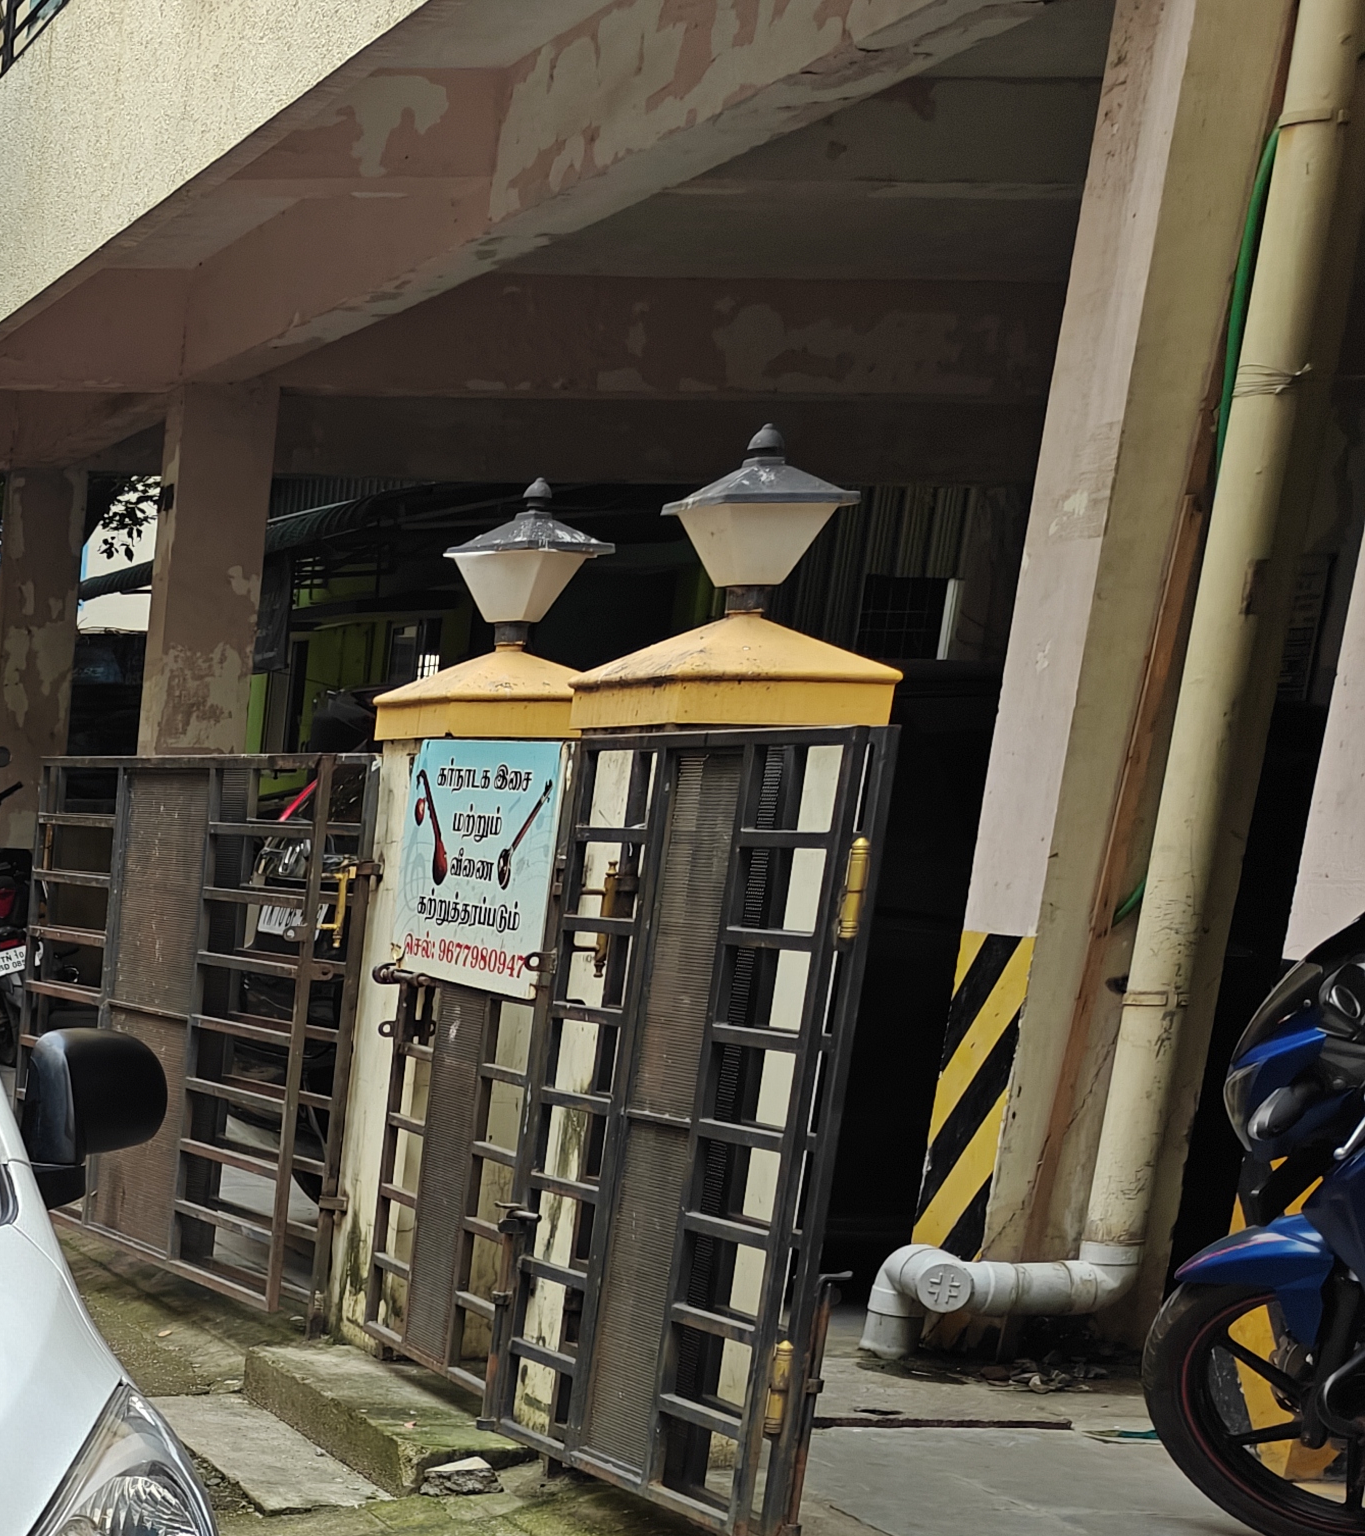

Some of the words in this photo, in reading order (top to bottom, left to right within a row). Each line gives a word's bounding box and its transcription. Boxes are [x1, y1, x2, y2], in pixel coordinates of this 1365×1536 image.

[494, 764, 532, 792] இசை
[453, 804, 502, 842] மற்றும்
[450, 847, 494, 881] வீணை
[417, 887, 520, 933] கற்றுத்தரப்படும்
[438, 939, 526, 979] 9677980947
